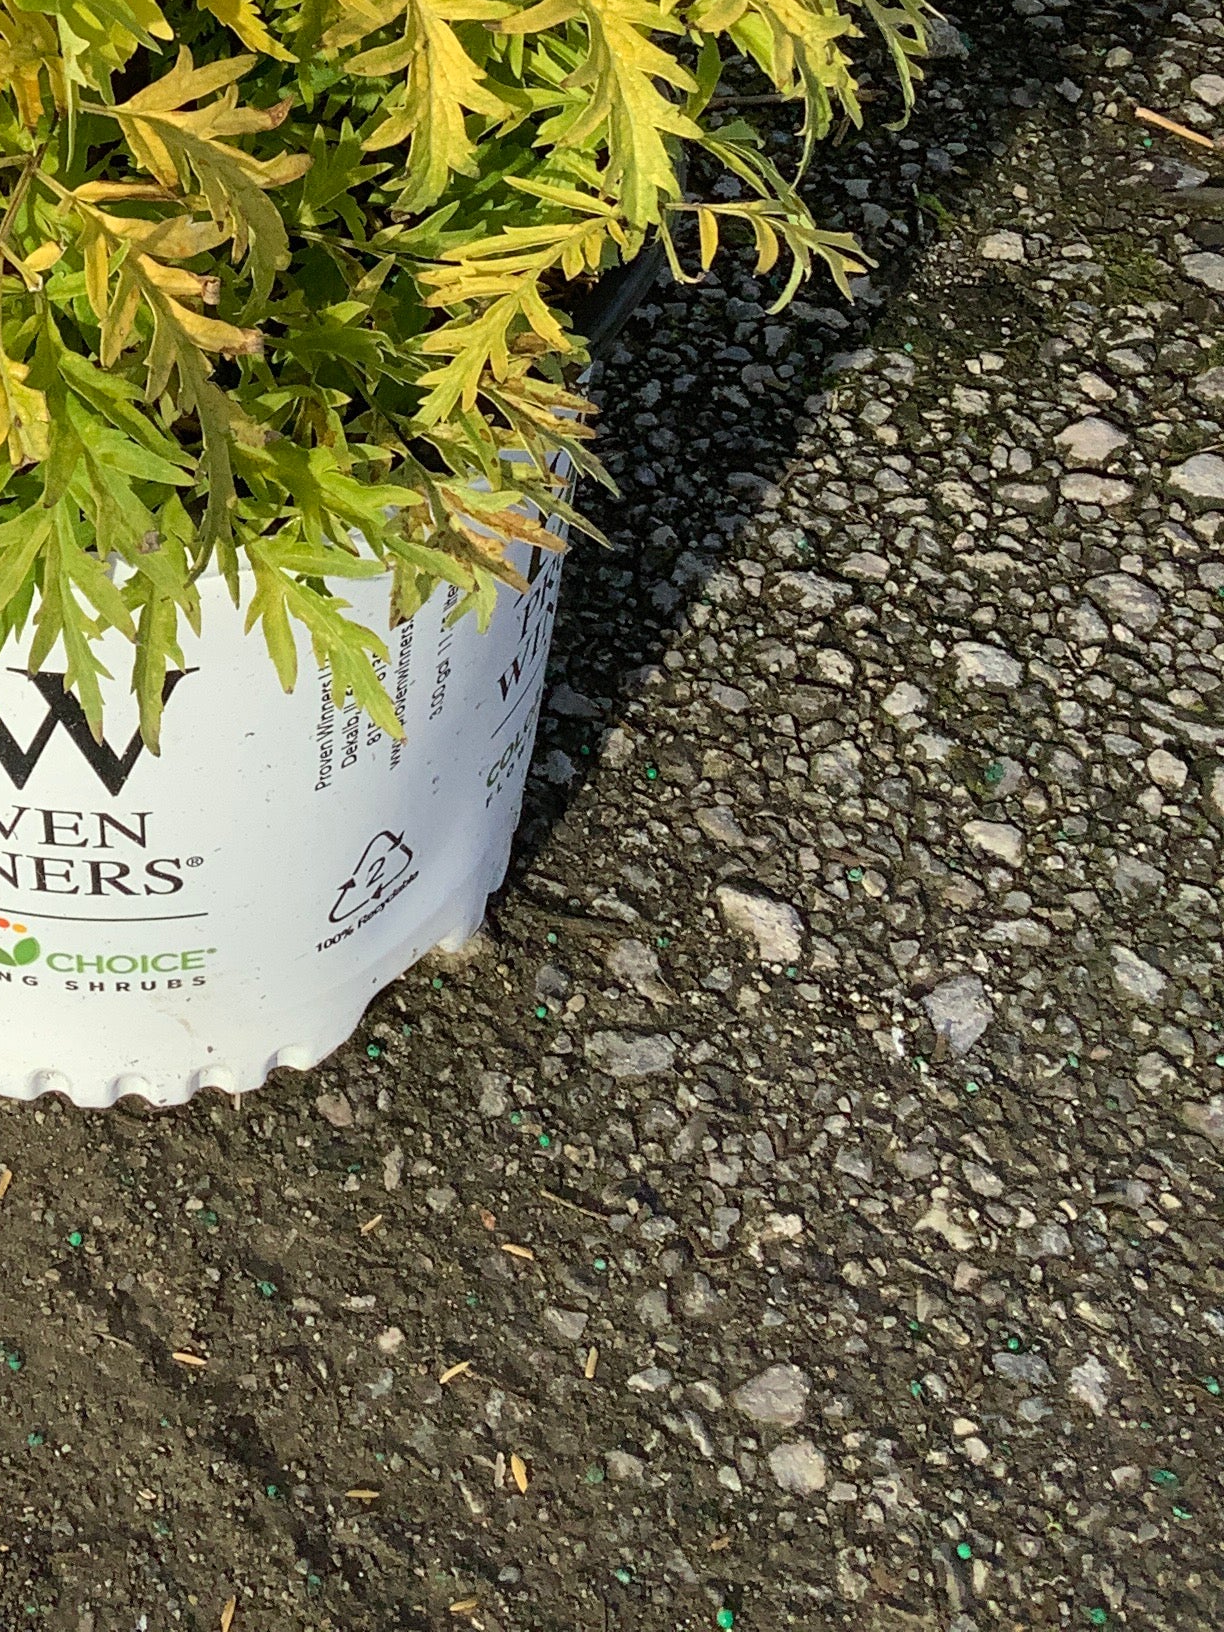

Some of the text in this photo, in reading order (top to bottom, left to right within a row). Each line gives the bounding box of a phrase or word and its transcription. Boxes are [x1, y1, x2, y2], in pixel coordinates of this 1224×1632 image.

[341, 710, 361, 769] Dekalb,
[315, 739, 333, 791] Proven
[366, 856, 386, 888] 2
[315, 924, 355, 952] 100%
[46, 950, 207, 974] CHOICE
[64, 976, 207, 993] SHRUBS
